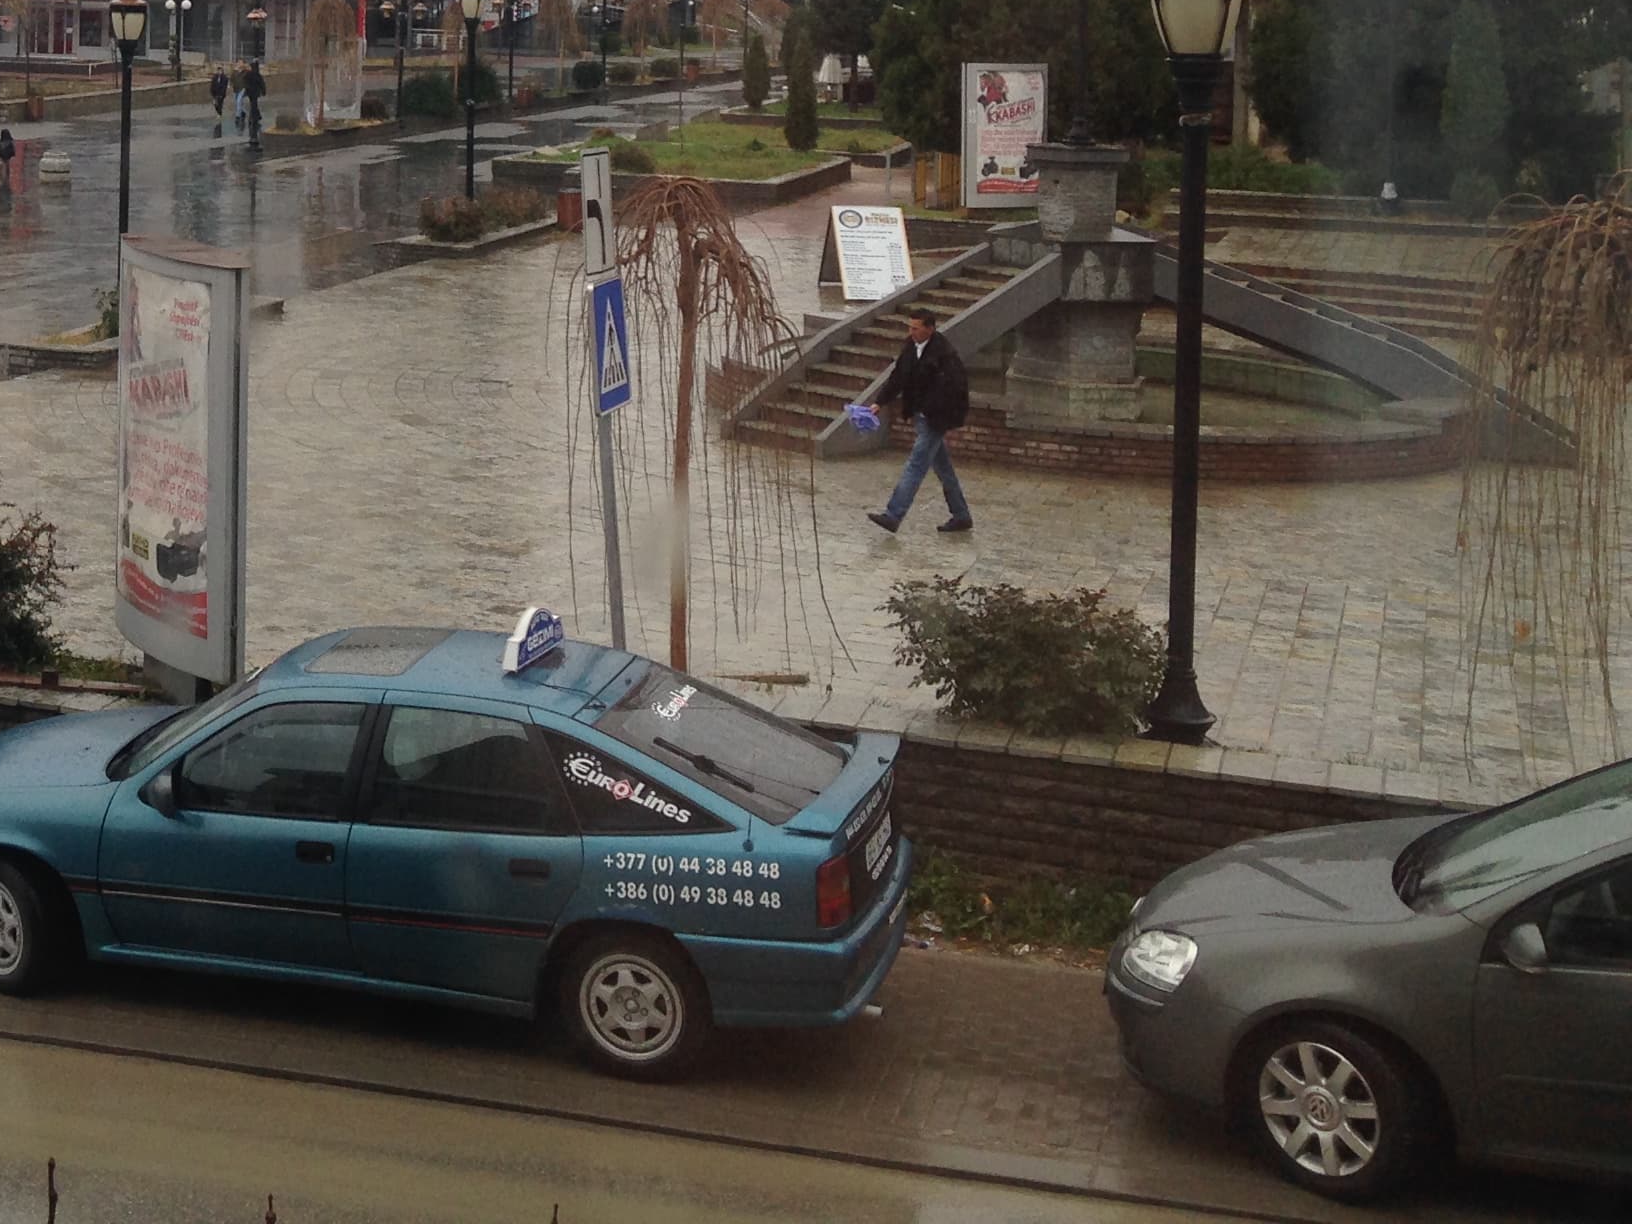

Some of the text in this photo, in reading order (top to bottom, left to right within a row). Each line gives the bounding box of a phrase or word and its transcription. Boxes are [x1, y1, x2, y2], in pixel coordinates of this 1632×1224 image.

[603, 852, 647, 870] +377
[679, 857, 701, 873] 44
[705, 858, 727, 875] 38
[731, 860, 753, 877] 48
[758, 862, 780, 879] 48
[604, 881, 781, 909] +386 (0) 49 38 48 48
